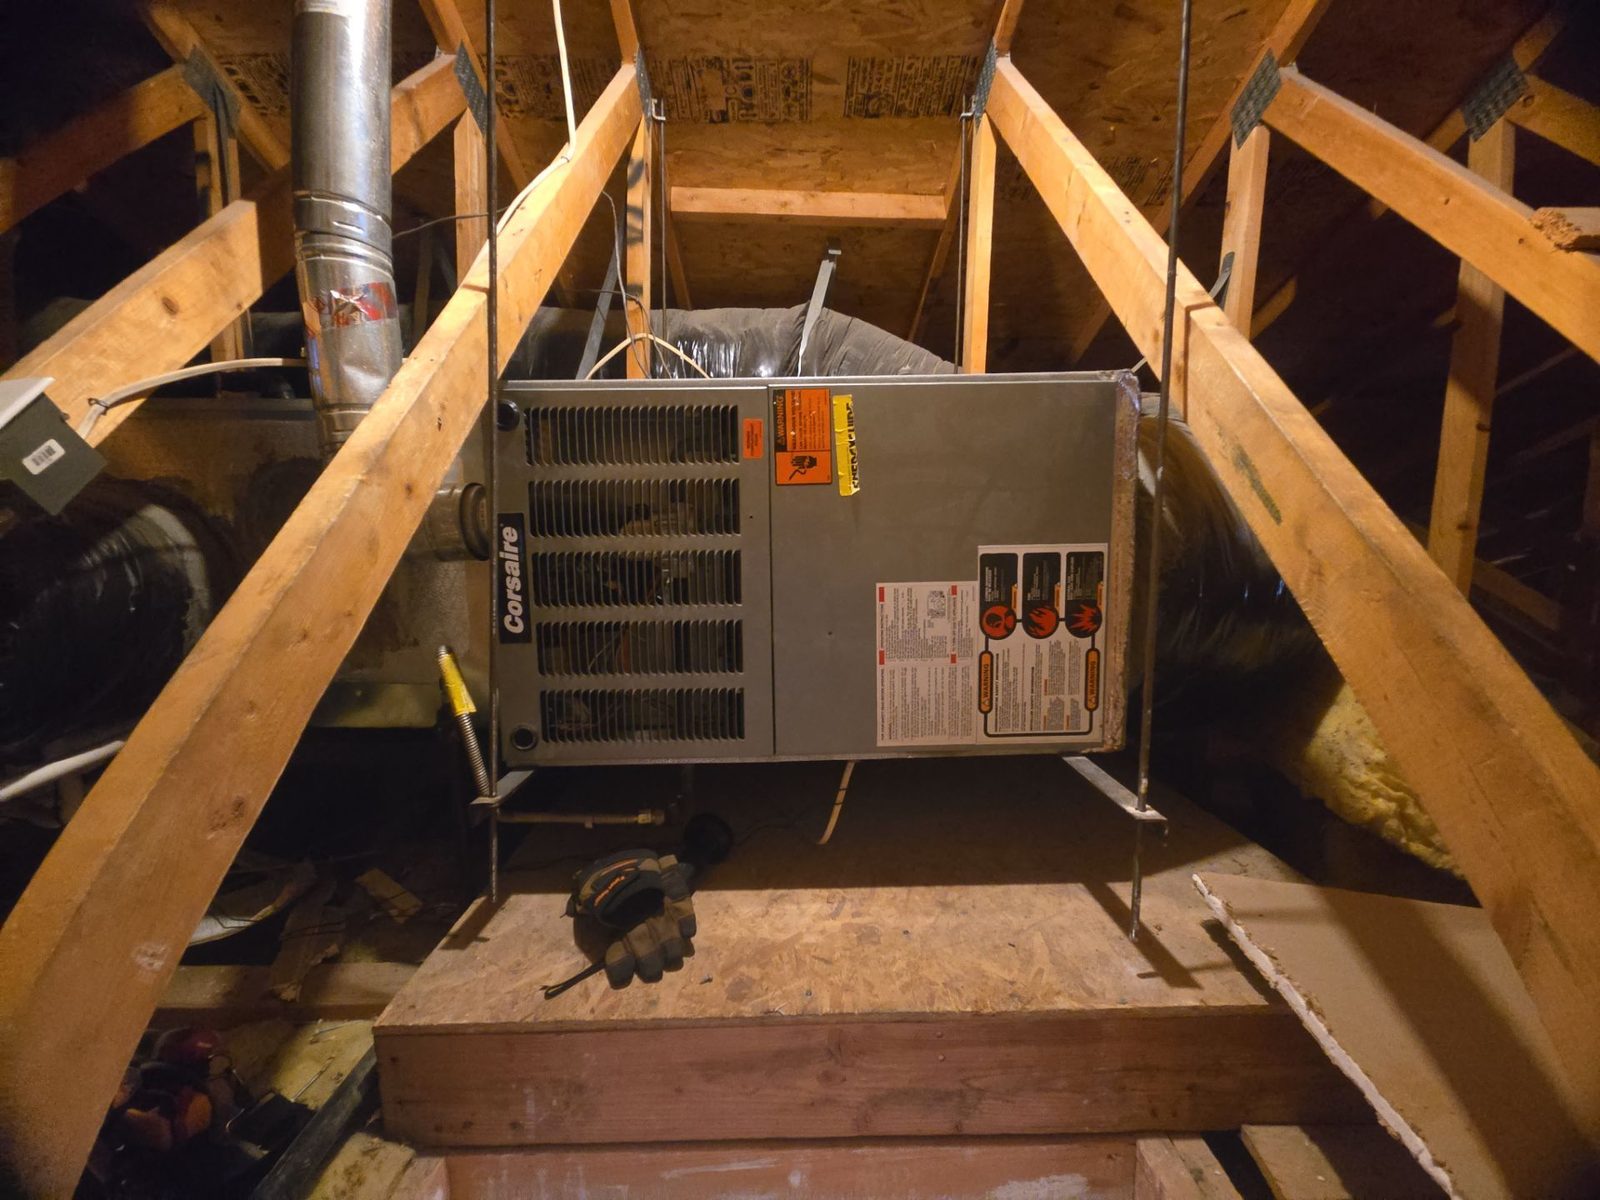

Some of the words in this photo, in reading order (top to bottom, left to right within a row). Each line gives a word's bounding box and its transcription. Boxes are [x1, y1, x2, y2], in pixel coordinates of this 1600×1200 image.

[776, 395, 785, 438] WARNING
[499, 526, 524, 634] Corsaire
[982, 663, 990, 698] WARNING
[1089, 660, 1097, 695] WARNING
